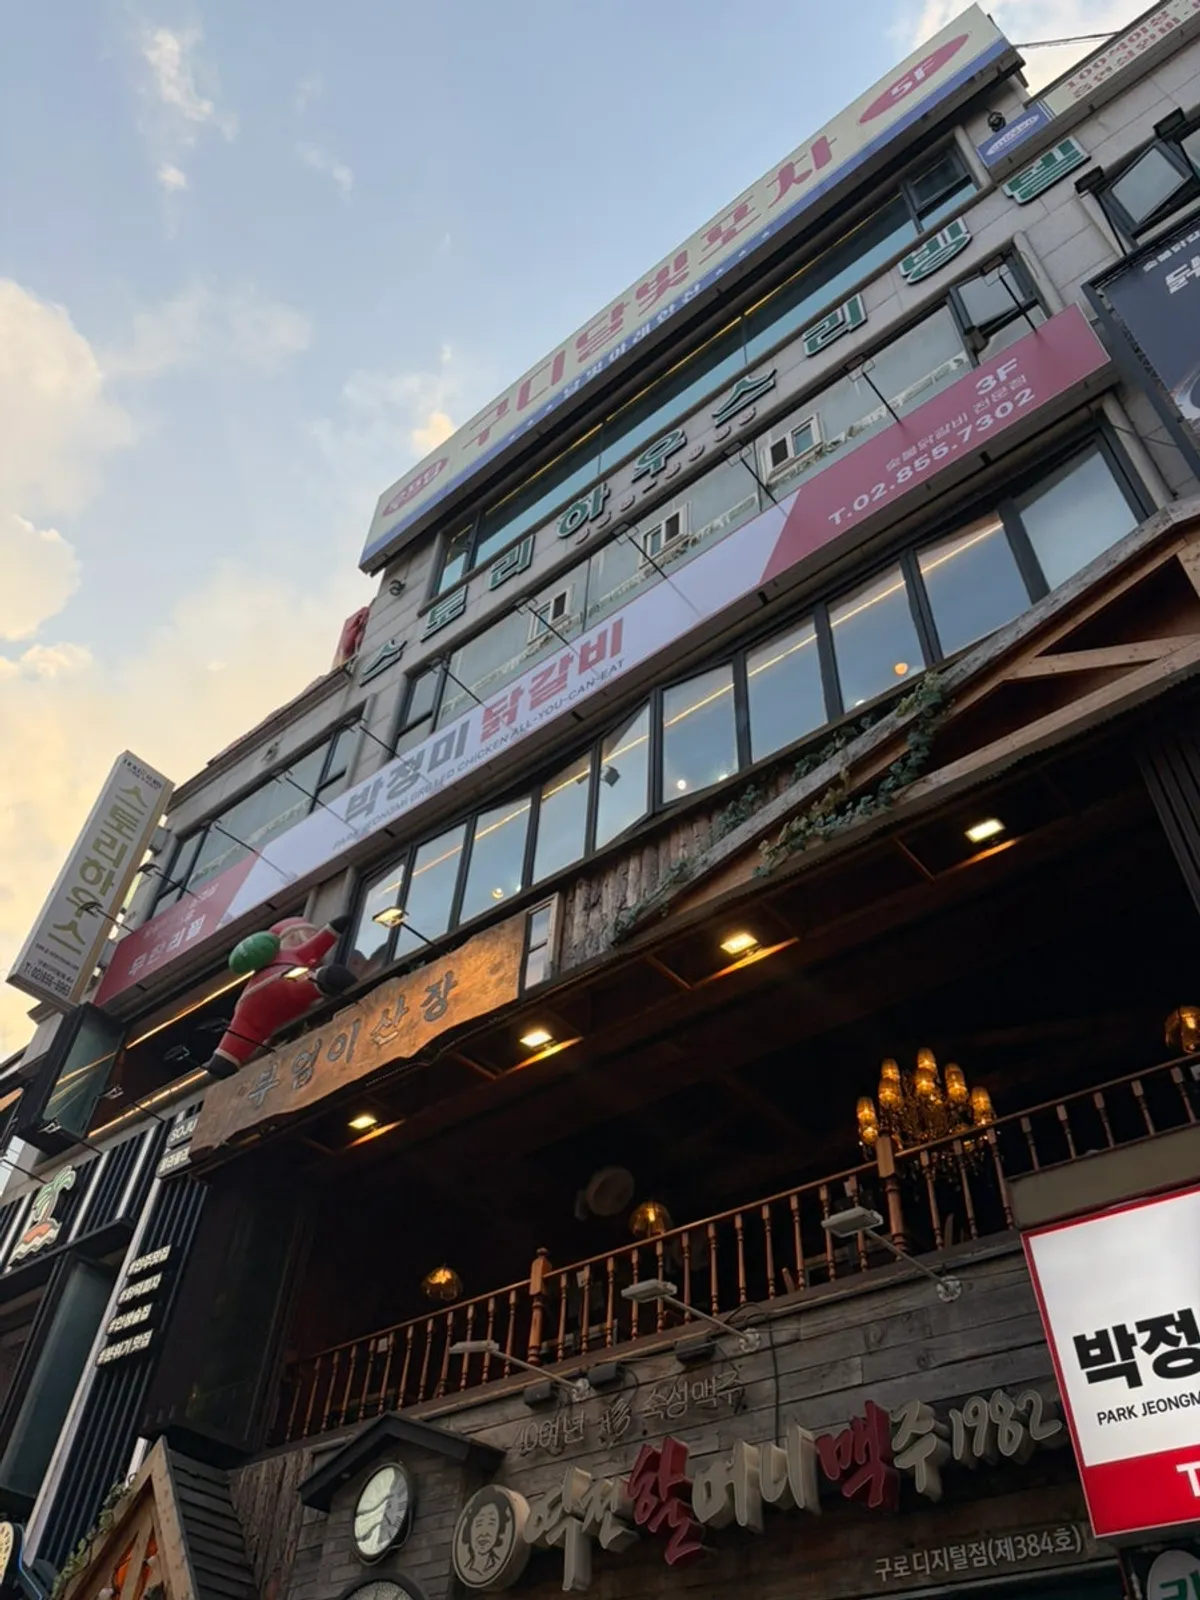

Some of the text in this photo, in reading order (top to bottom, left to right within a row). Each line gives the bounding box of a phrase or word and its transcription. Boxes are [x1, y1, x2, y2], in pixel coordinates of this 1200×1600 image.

[890, 55, 937, 97] 5F
[461, 136, 839, 451] 구디달빛포차
[975, 358, 1018, 395] 3F
[828, 388, 1036, 525] T.02.855.7302
[344, 617, 624, 824] 박정미 닭갈비
[247, 969, 458, 1110] 부엉이산장
[642, 1369, 744, 1419] 숙성맥주
[1097, 1404, 1138, 1426] PARK
[875, 1524, 1083, 1583] 구로디지털점(제384호)
